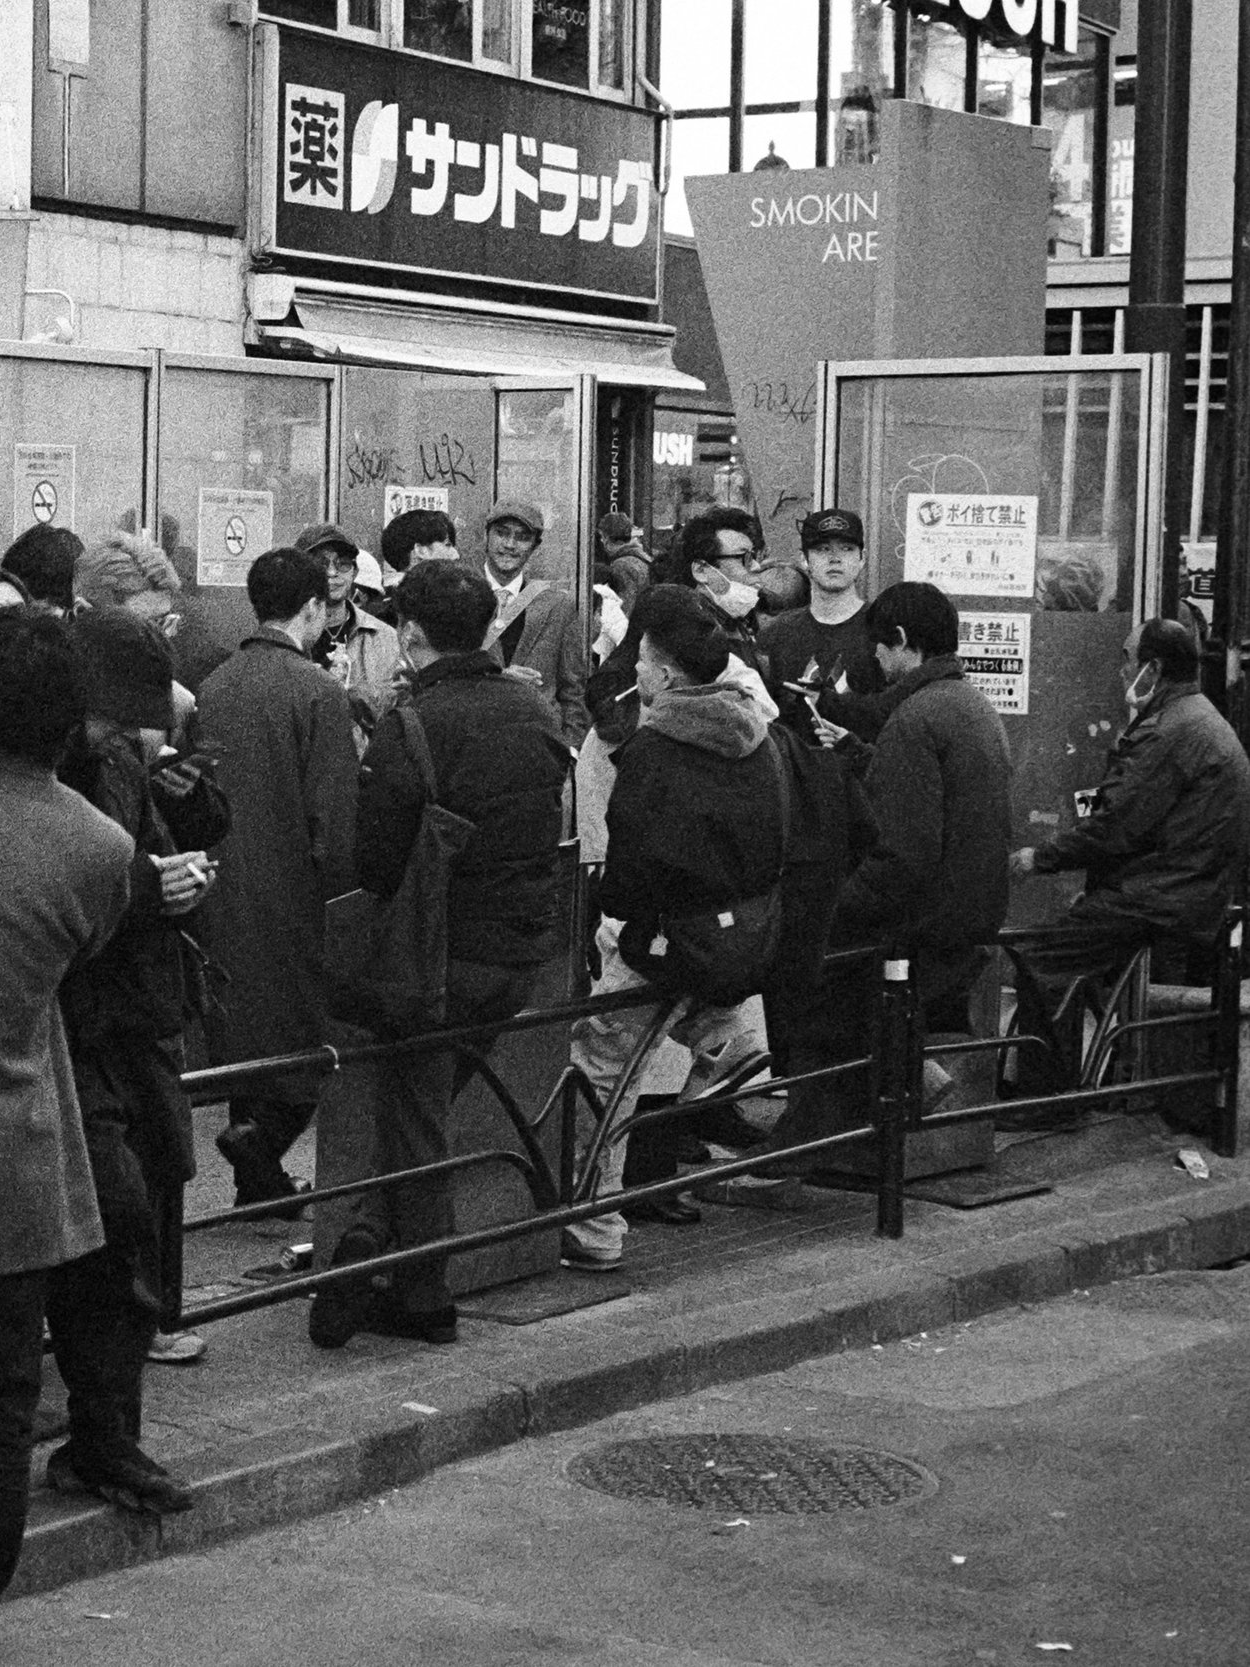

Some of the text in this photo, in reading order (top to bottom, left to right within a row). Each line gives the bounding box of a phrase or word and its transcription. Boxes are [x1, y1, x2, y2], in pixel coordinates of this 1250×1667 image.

[289, 96, 653, 249] 薬 サンドラッグ
[750, 190, 878, 228] SMOKIN
[821, 231, 879, 263] ARE
[947, 502, 1027, 525] ポイ捨て禁止
